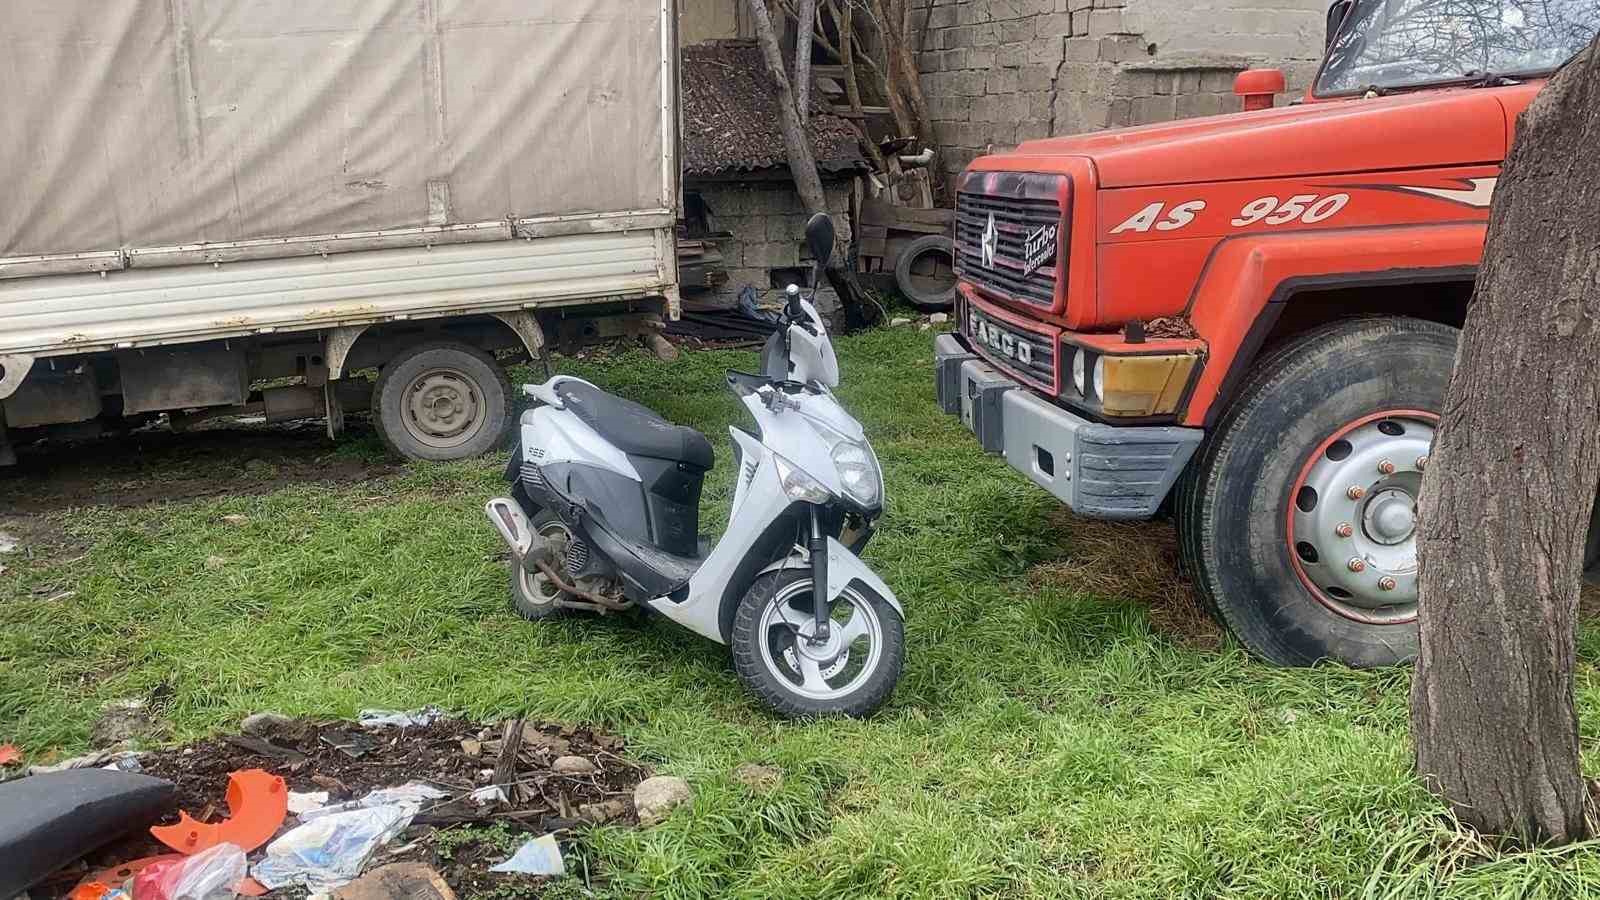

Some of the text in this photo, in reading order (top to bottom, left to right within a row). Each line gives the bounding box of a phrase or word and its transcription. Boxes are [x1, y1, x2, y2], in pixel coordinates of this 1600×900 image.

[1108, 193, 1350, 234] AS 950
[1024, 224, 1056, 260] Turbo
